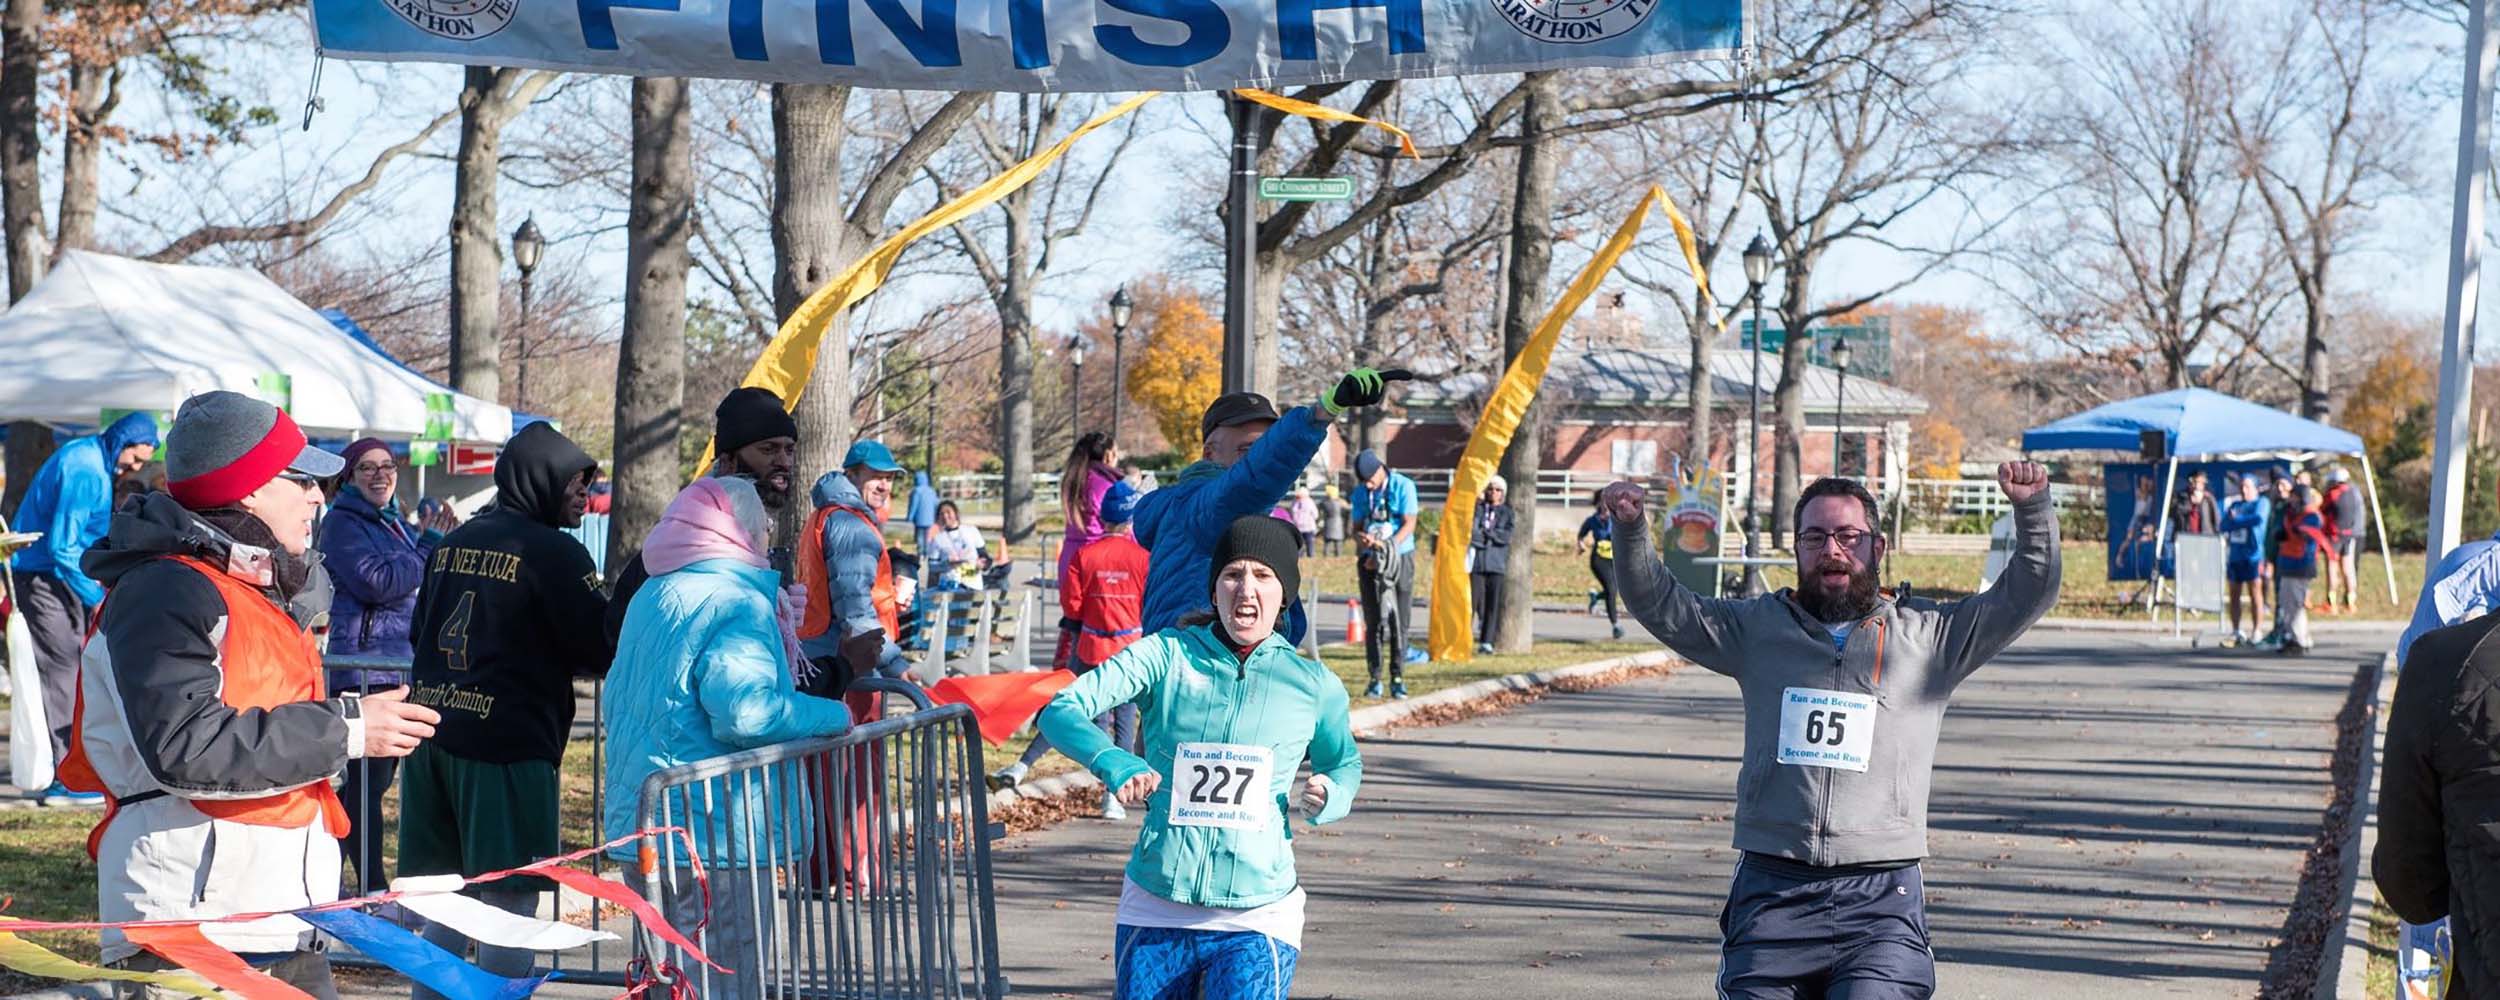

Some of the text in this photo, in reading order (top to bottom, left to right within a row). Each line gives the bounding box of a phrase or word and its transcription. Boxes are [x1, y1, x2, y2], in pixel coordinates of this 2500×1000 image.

[449, 548, 481, 575] NEE
[478, 550, 521, 583] KUJA
[438, 590, 477, 671] 4
[442, 682, 495, 719] Coming
[1790, 694, 1869, 710] Run and Become
[1806, 709, 1847, 746] 65
[1183, 749, 1202, 759] Run
[1204, 751, 1222, 760] and
[1785, 747, 1861, 762] Become and Run
[1189, 764, 1255, 805] 227
[1178, 807, 1214, 818] Become
[1217, 810, 1236, 820] and
